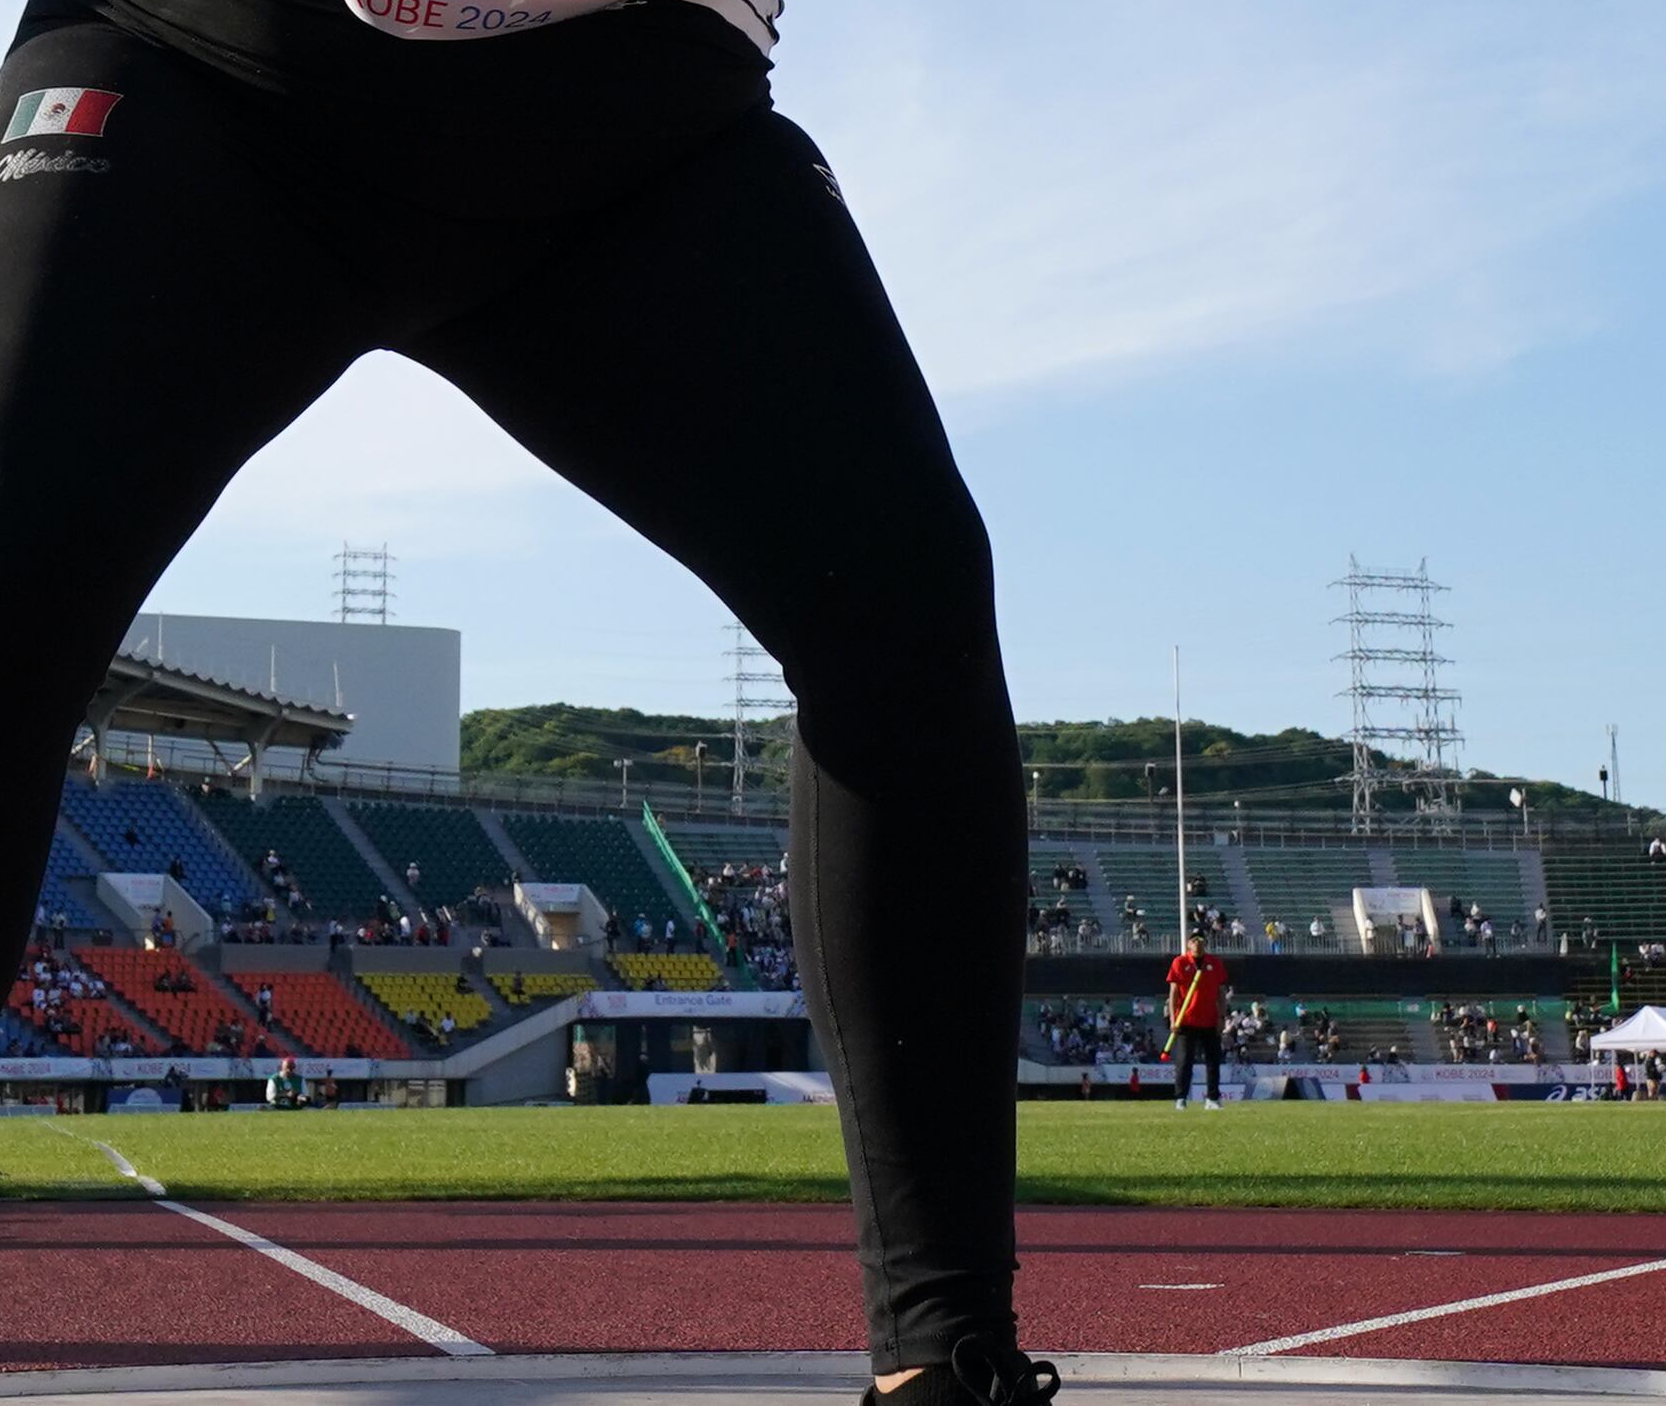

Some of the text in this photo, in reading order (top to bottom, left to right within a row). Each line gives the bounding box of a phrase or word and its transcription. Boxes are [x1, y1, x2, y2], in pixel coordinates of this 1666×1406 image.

[456, 5, 553, 31] 2024
[655, 994, 732, 1005] Entrance Gate
[1436, 1069, 1495, 1078] KOBE 2024
